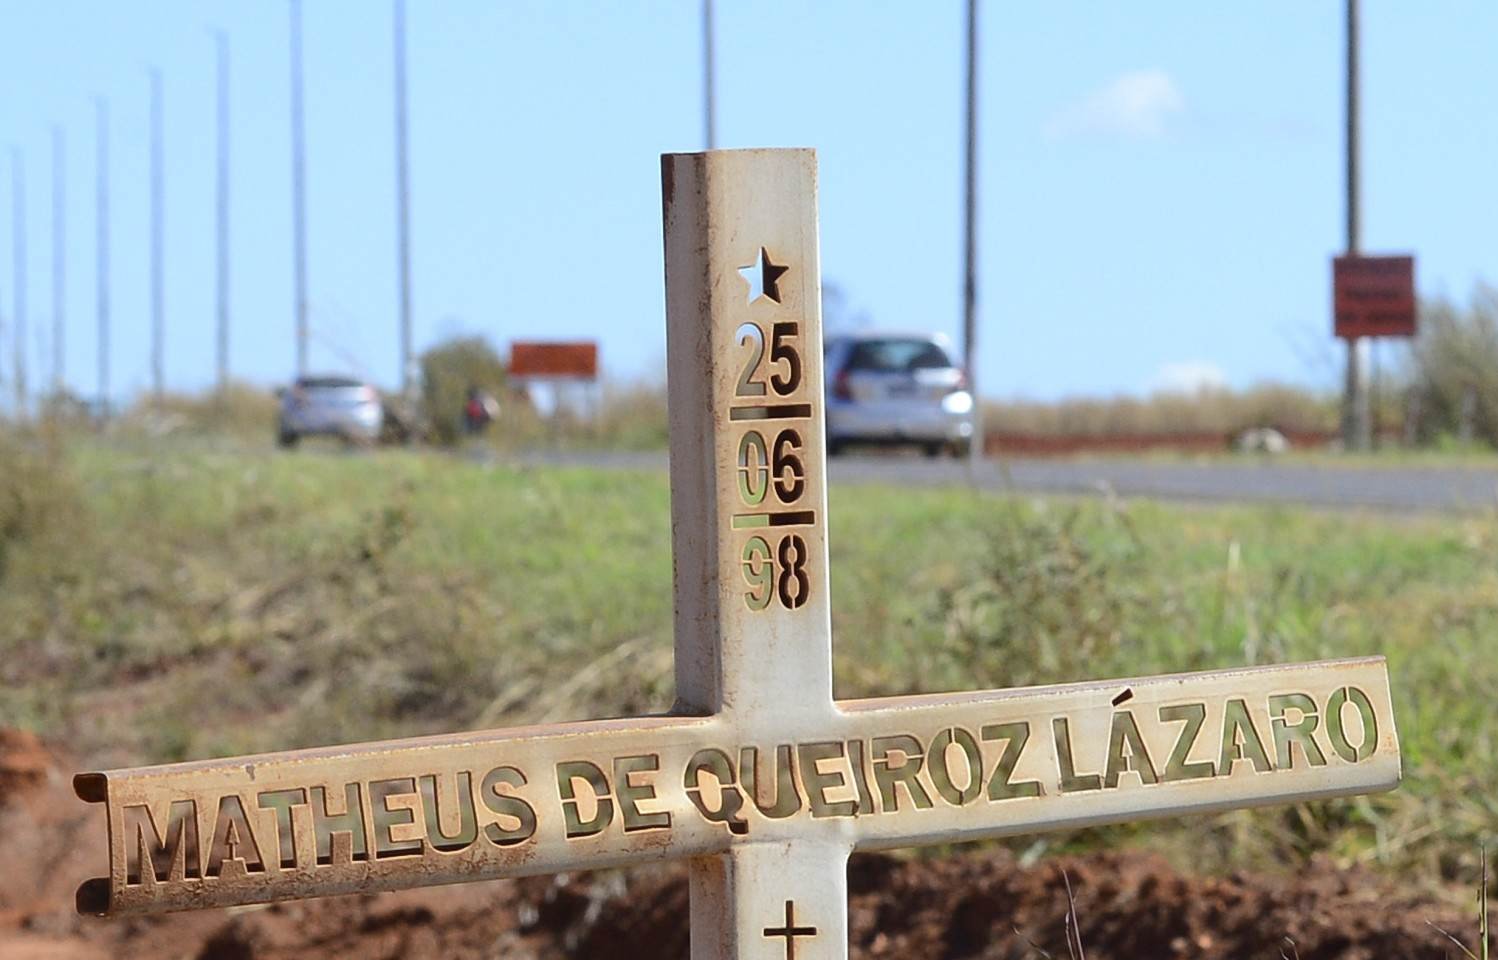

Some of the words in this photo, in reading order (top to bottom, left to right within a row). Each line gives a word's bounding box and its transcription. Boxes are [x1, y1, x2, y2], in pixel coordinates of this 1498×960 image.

[734, 320, 802, 398] 25
[738, 428, 805, 505] 06
[742, 534, 810, 611] 98
[123, 765, 537, 886] MATHEUS
[555, 753, 673, 839] DE
[684, 720, 1046, 835] QUEIROZ
[1052, 685, 1380, 794] LÁZARO
